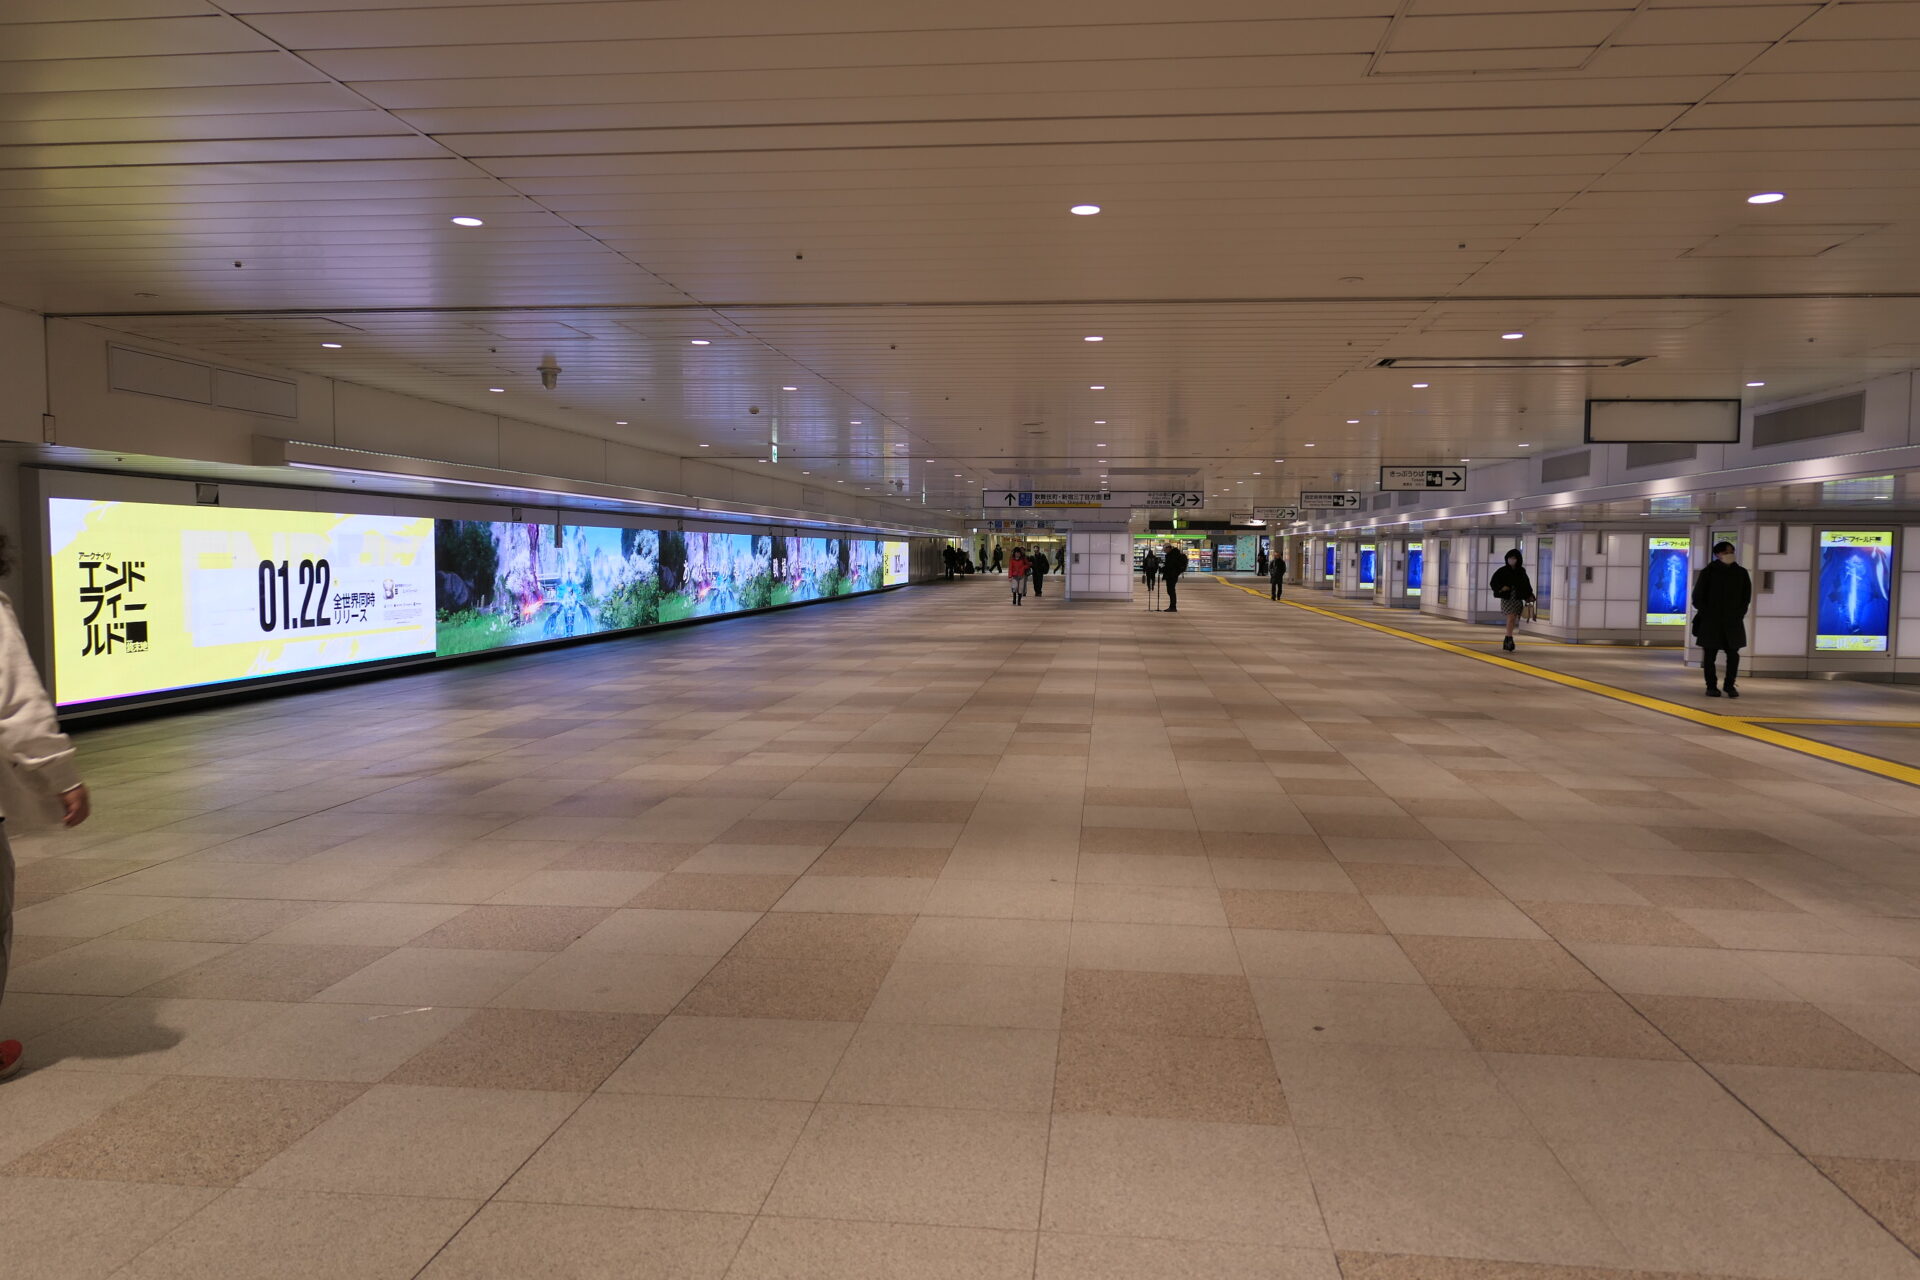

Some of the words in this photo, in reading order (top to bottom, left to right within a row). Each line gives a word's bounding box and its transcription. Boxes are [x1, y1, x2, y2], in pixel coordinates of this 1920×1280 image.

[79, 552, 112, 560] アークナイツ
[79, 561, 145, 593] エンド
[80, 593, 147, 626] フィー
[258, 559, 331, 632] 01.22
[333, 592, 376, 610] 全世界同時
[334, 609, 368, 625] リリース
[82, 622, 125, 657] ルド
